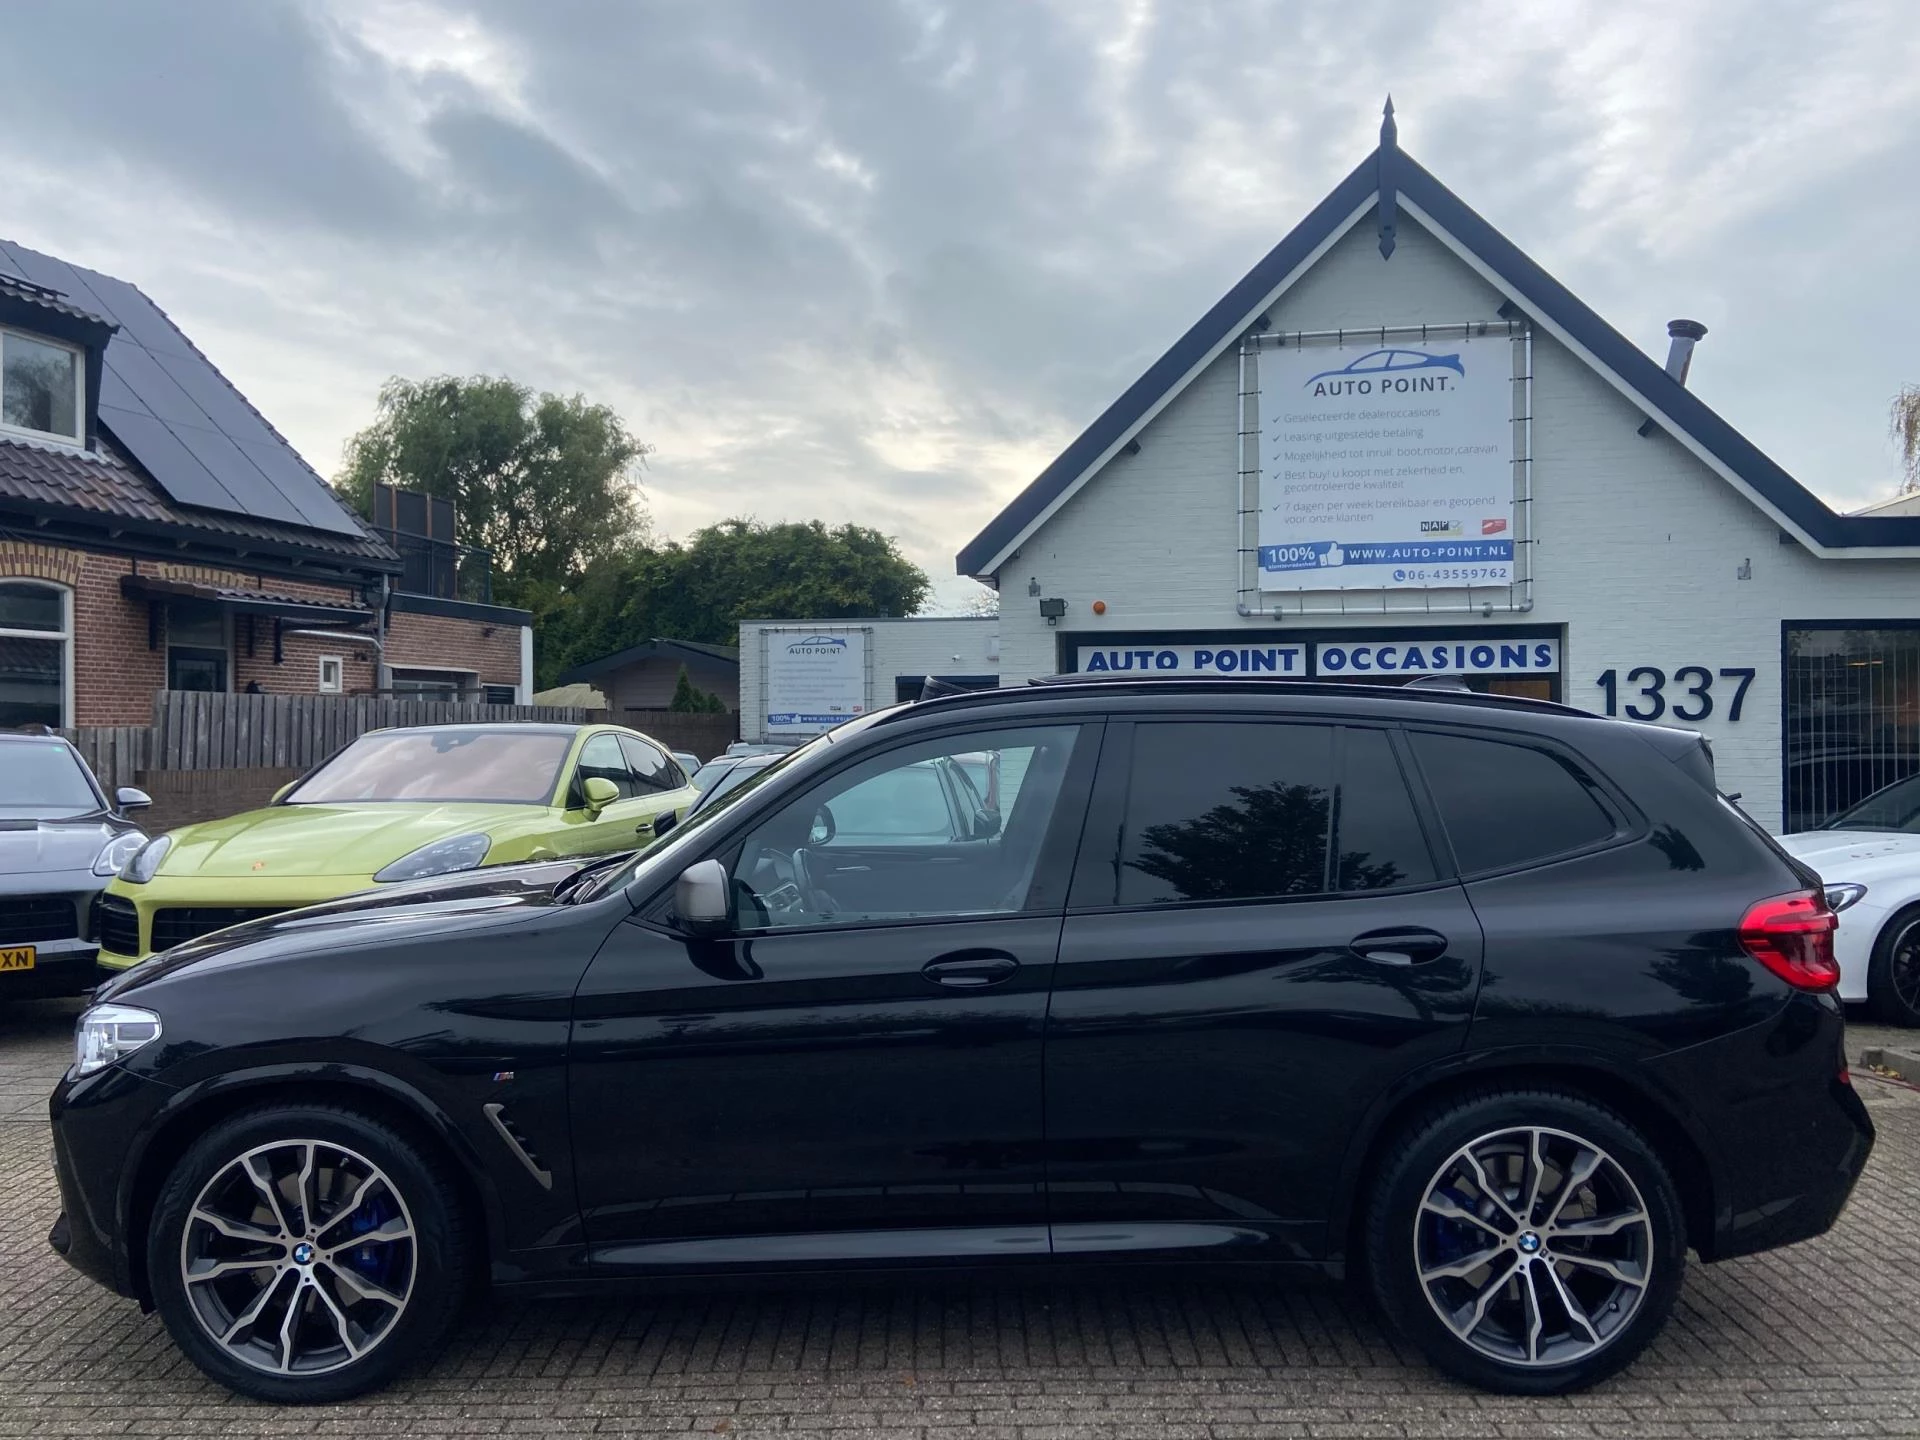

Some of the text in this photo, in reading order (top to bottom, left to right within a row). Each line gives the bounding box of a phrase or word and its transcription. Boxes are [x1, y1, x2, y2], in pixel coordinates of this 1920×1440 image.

[1314, 380, 1372, 397] AUTO
[1284, 407, 1440, 424] Geselecteerde dealeroccasions
[1383, 428, 1424, 440] betaling
[1284, 449, 1346, 463] Mogelijkheid
[1349, 449, 1363, 458] tot
[1284, 470, 1306, 480] Best
[1332, 470, 1339, 478] u
[1342, 467, 1371, 479] koopt
[1374, 466, 1394, 477] met
[1396, 463, 1447, 477] zekerheid
[1284, 478, 1404, 495] gecontroleerde kwaliteit
[1284, 495, 1496, 513] 7 dagen per week bereikbaar en geopend
[1284, 512, 1374, 525] voor onze klanten
[1421, 520, 1449, 532] NAP
[1268, 546, 1316, 563] 100%
[1349, 546, 1508, 559] WWW.AUTO-POINT.NL
[1408, 567, 1507, 580] 06-43559762
[789, 647, 812, 655] AUTO
[1322, 644, 1552, 671] OCCASIONS
[1086, 649, 1299, 672] AUTO POINT
[1596, 666, 1756, 721] 1337
[772, 714, 791, 723] 100%
